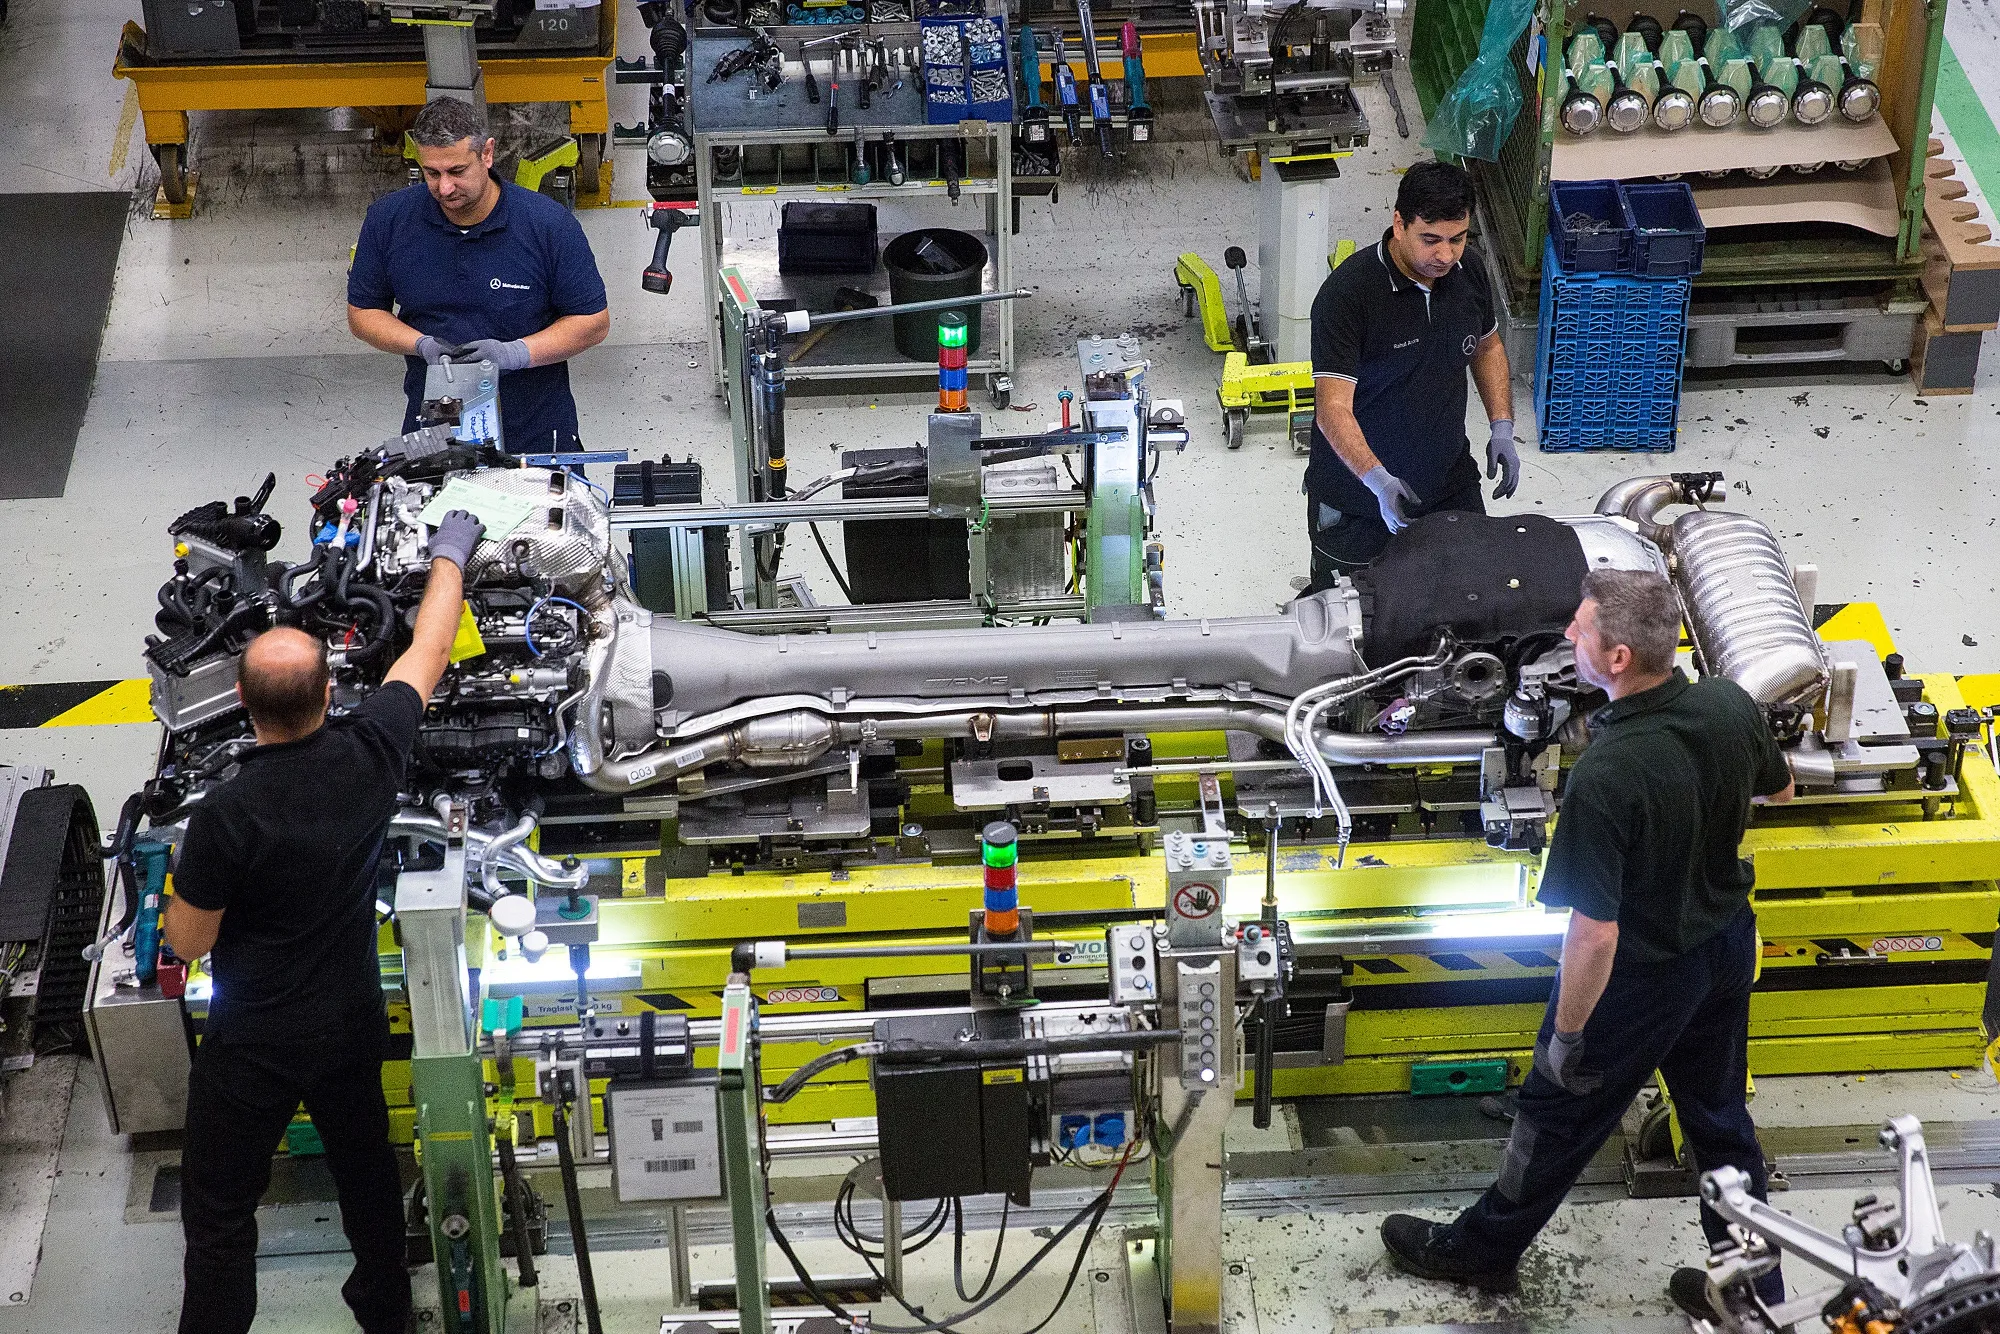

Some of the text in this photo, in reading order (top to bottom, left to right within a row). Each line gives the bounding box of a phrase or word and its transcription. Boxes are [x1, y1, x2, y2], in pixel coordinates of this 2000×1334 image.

[538, 18, 568, 31] 120
[630, 766, 653, 781] Q03
[538, 1004, 573, 1014] Traglast
[601, 1003, 612, 1011] kg
